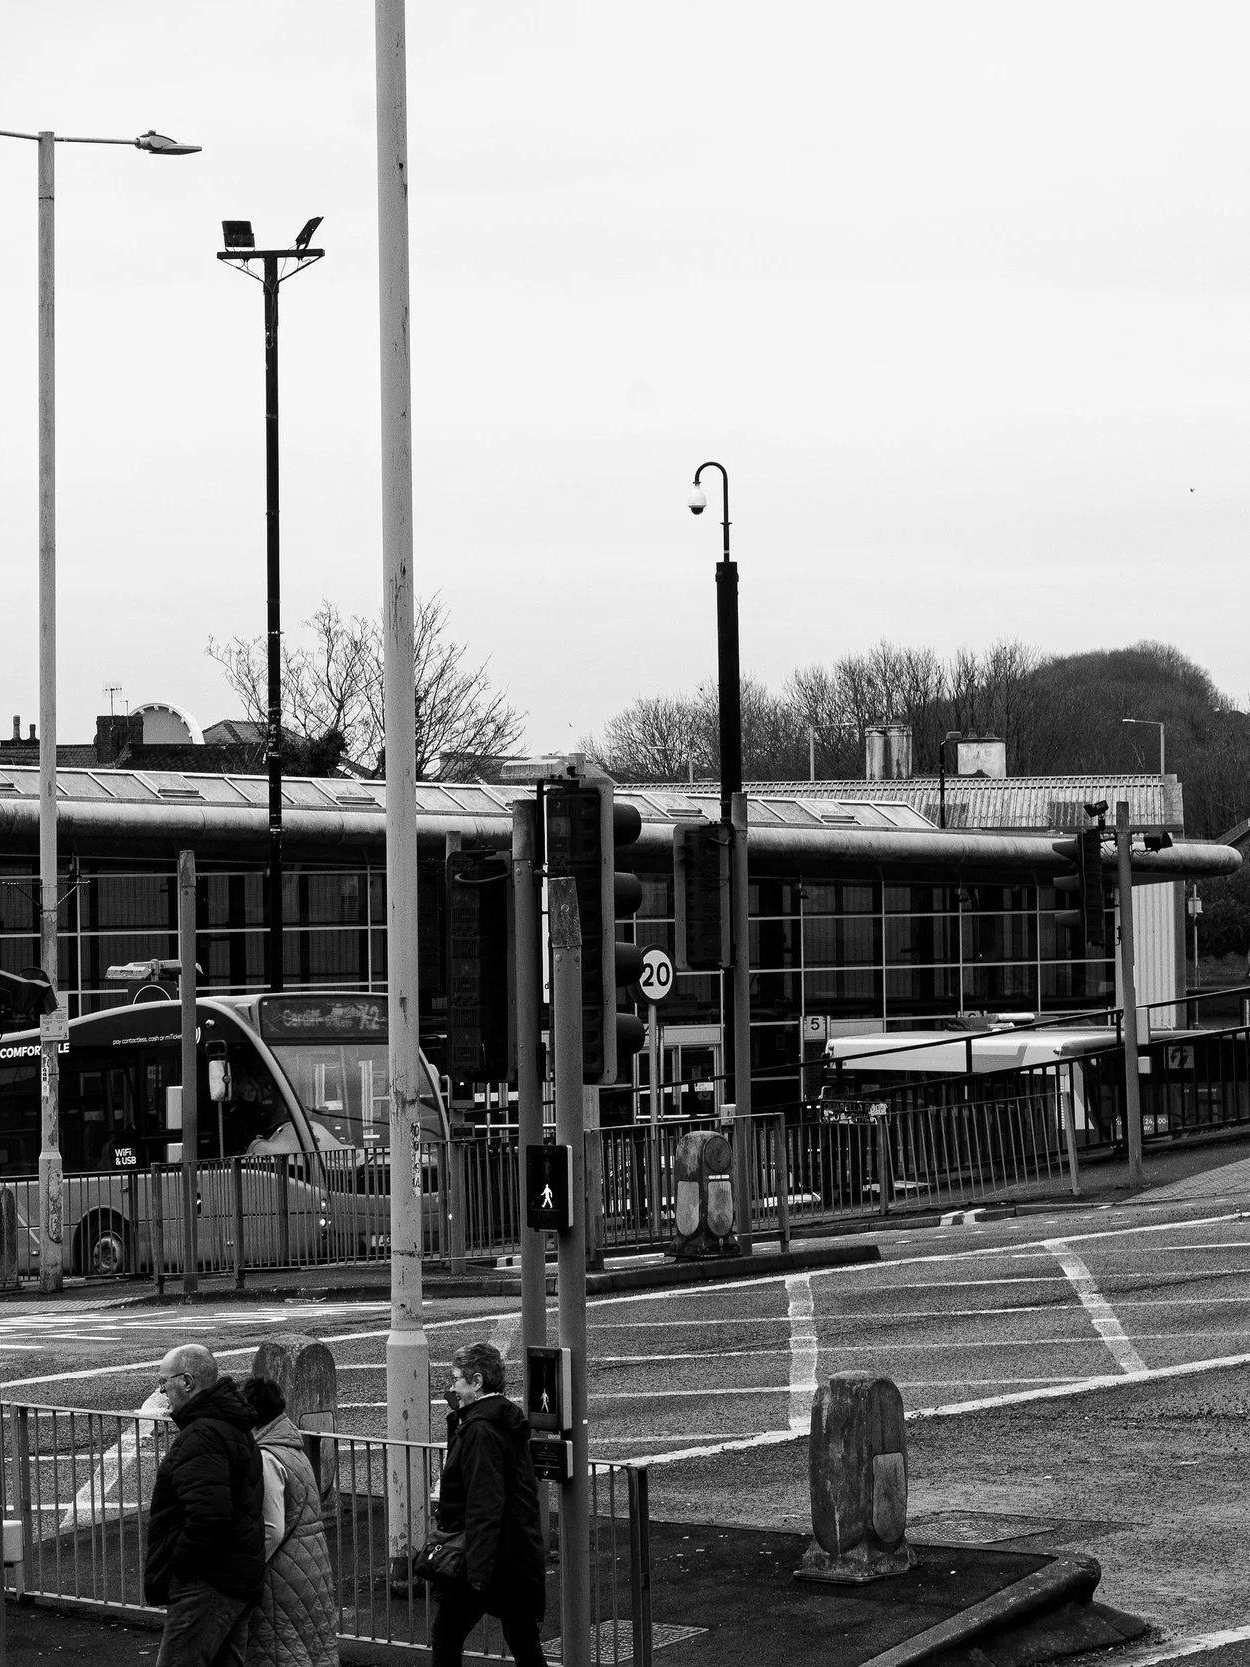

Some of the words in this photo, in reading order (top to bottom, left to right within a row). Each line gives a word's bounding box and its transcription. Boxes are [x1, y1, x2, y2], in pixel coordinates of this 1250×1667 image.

[642, 961, 671, 987] 20
[810, 1017, 820, 1031] 5
[0, 1042, 70, 1059] COMFORLE
[114, 1147, 132, 1157] WiFi
[115, 1157, 122, 1166] &
[121, 1156, 137, 1165] USB
